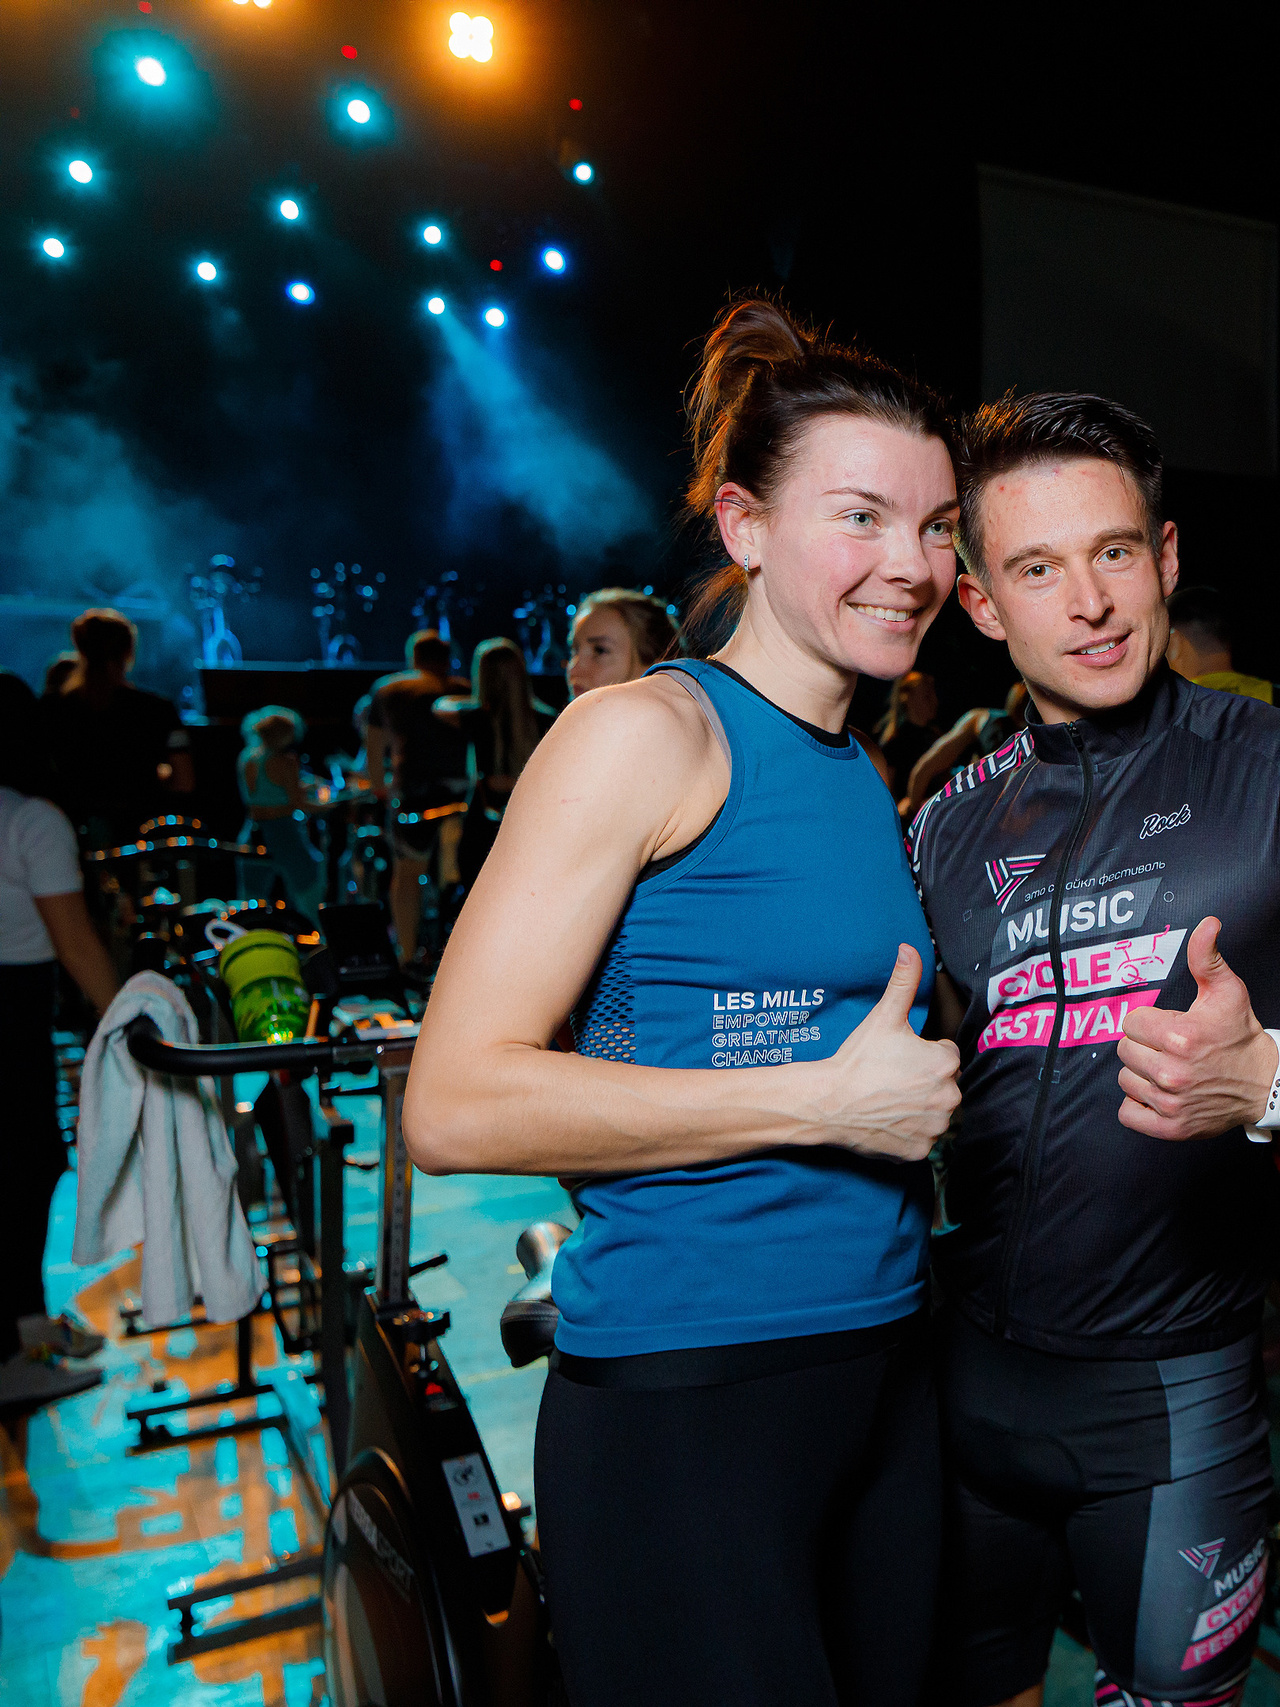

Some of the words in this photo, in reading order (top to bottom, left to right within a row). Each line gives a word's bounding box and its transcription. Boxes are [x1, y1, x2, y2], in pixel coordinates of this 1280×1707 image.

[1139, 803, 1192, 839] Rock
[1024, 887, 1046, 902] это
[1098, 861, 1166, 887] фестиваль
[1007, 890, 1135, 951] MUSIC
[998, 951, 1112, 998] CYCLE
[713, 992, 755, 1011] LES
[762, 988, 825, 1009] MILLS
[712, 1010, 810, 1030] EMPOWER
[711, 1026, 821, 1048] GREATNESS
[711, 1047, 793, 1068] CHANGE
